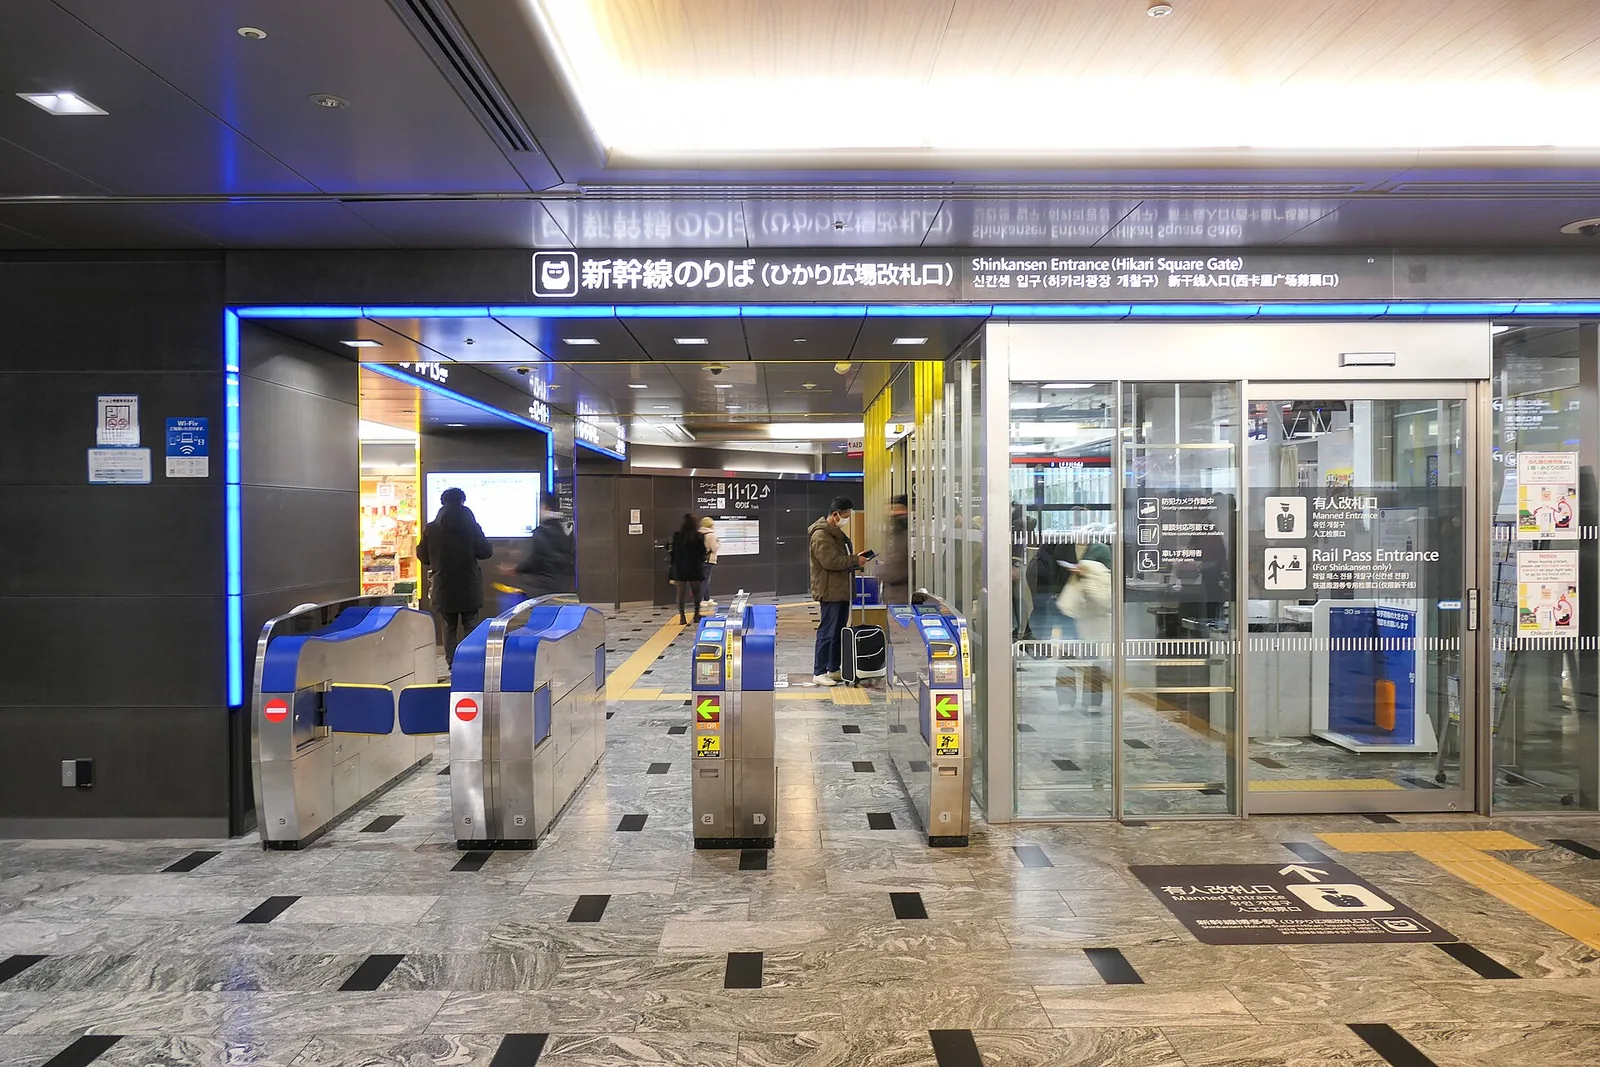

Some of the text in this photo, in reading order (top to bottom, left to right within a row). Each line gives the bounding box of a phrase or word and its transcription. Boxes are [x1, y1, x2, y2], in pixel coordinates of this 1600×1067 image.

[972, 257, 1244, 273] Shinkansen Entrance (Hikari Square Gate)
[581, 257, 954, 289] 新幹線のりば (ひかり広場改札口)
[972, 274, 1011, 288] 신칸센
[735, 501, 750, 509] のりば
[1161, 497, 1214, 506] 防犯カメラ作動中
[1313, 496, 1378, 510] 有人改札口
[1313, 511, 1344, 520] Manned
[1161, 549, 1203, 558] 車いす利用者
[1312, 547, 1440, 562] Rail Pass Entrance
[1312, 563, 1392, 573] (For Shinkansen only)
[1160, 885, 1278, 895] 有人改札口
